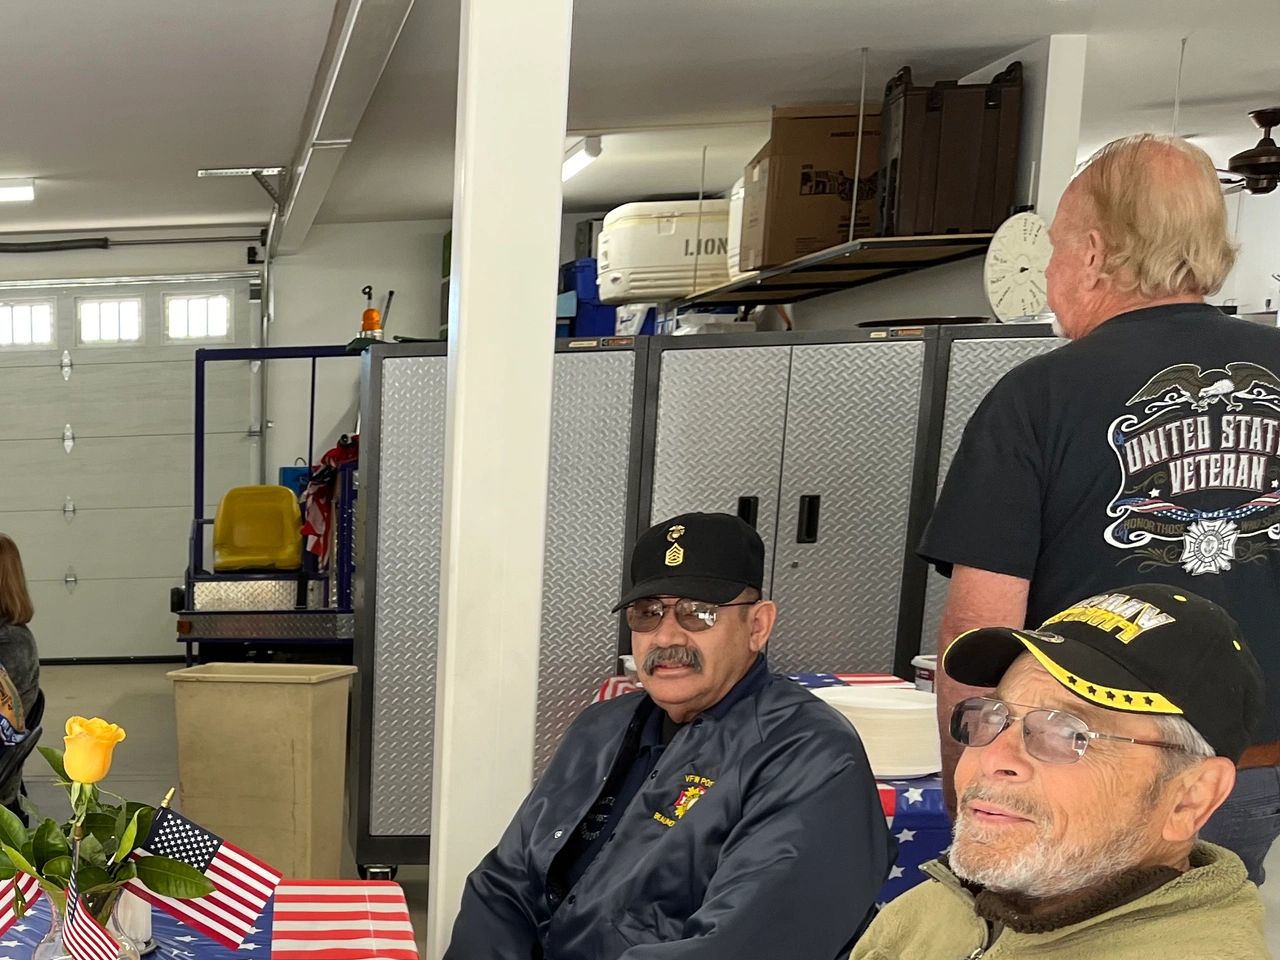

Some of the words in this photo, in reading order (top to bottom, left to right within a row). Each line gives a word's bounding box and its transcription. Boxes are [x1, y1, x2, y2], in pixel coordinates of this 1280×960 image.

[684, 238, 728, 256] LION
[1123, 415, 1211, 474] UNITED
[1221, 415, 1280, 456] STAT
[1169, 453, 1267, 495] VETERAN
[1124, 518, 1156, 533] HONOR
[1156, 520, 1185, 534] THOSE
[684, 774, 701, 784] VFW
